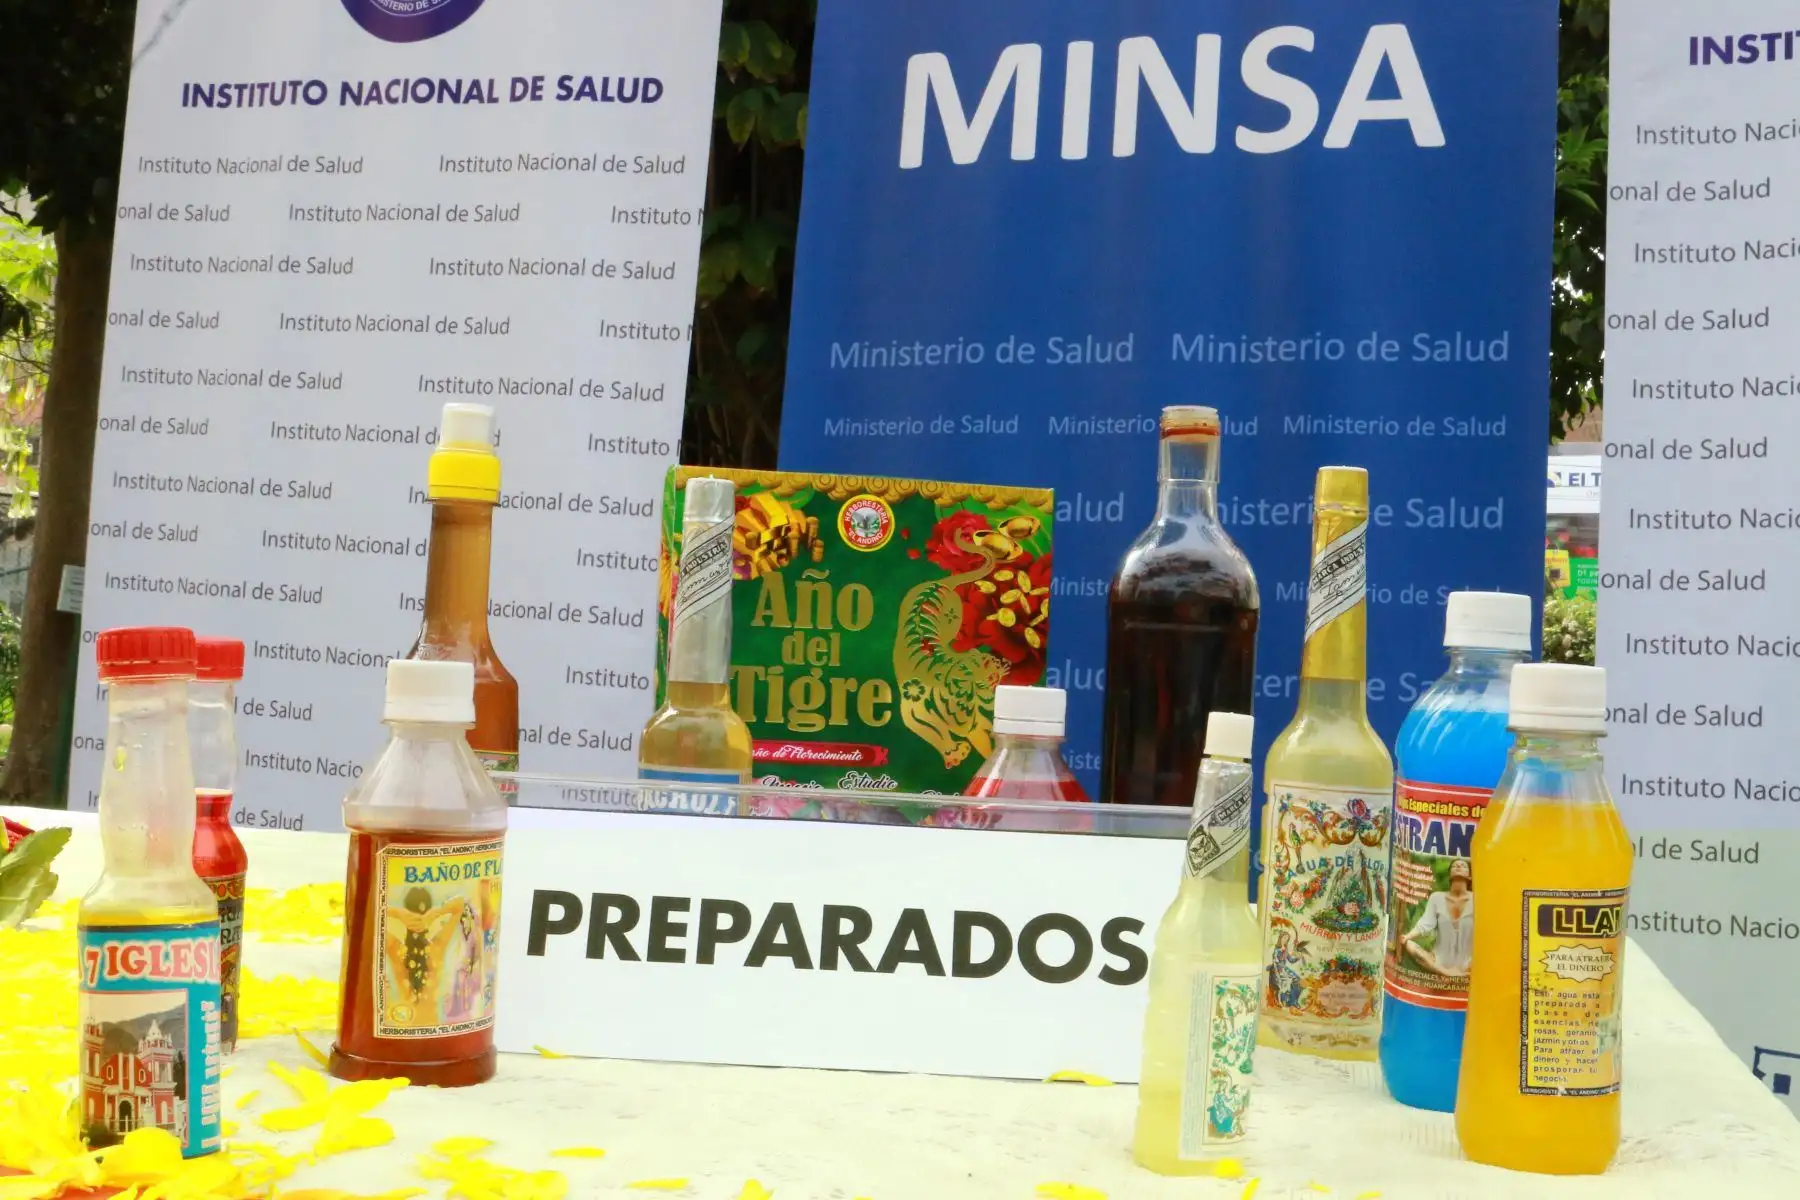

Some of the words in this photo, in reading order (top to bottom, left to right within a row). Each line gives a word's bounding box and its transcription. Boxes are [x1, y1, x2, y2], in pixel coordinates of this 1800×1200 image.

[183, 80, 327, 108] INSTITUTO
[340, 78, 499, 106] NACIONAL
[510, 76, 544, 102] DE
[556, 75, 663, 103] SALUD
[900, 24, 1445, 169] MINSA
[1637, 125, 1736, 144] Instituto
[139, 156, 211, 174] Instituto
[217, 156, 282, 174] Nacional
[288, 155, 309, 172] de
[315, 156, 363, 173] Salud
[440, 156, 512, 172] Instituto
[518, 154, 596, 171] Nacional
[603, 155, 627, 172] de
[633, 156, 685, 174] Salud
[1667, 182, 1695, 201] de
[1705, 177, 1770, 201] Salud
[157, 204, 179, 220] de
[185, 205, 229, 221] Salud
[290, 204, 361, 222] Instituto
[367, 204, 440, 221] Nacional
[446, 205, 468, 222] de
[474, 203, 519, 222] Salud
[612, 206, 691, 225] Instituto
[131, 254, 202, 273] Instituto
[208, 255, 273, 272] Nacional
[278, 256, 301, 273] de
[307, 257, 353, 274] Salud
[1636, 243, 1735, 263] Instituto
[430, 258, 503, 276] Instituto
[509, 258, 585, 275] Nacional
[592, 259, 616, 278] de
[623, 261, 675, 280] Salud
[149, 310, 170, 327] de
[176, 312, 219, 329] Salud
[280, 313, 351, 331] Instituto
[356, 315, 429, 332] Nacional
[436, 316, 458, 334] de
[464, 317, 509, 334] Salud
[1665, 310, 1694, 330] de
[1703, 307, 1769, 330] Salud
[600, 320, 680, 341] Instituto
[831, 337, 984, 368] Ministerio
[996, 335, 1035, 363] de
[1047, 333, 1133, 363] Salud
[1172, 332, 1344, 363] Ministerio
[1357, 331, 1400, 361] de
[1412, 331, 1508, 361] Salud
[122, 366, 193, 385] Instituto
[198, 369, 263, 386] Nacional
[269, 370, 291, 388] de
[297, 372, 342, 389] Salud
[419, 375, 493, 395] Instituto
[499, 378, 573, 396] Nacional
[580, 379, 604, 398] de
[610, 381, 664, 401] Salud
[1633, 379, 1734, 399] Instituto
[141, 416, 162, 433] de
[167, 418, 208, 435] Salud
[271, 421, 341, 441] Instituto
[346, 424, 419, 443] Nacional
[825, 417, 923, 436] Ministerio
[930, 415, 954, 433] de
[961, 415, 1018, 433] Salud
[1049, 415, 1155, 434] Ministerio
[1284, 415, 1399, 435] Ministerio
[1407, 416, 1435, 435] de
[1443, 416, 1505, 436] Salud
[589, 434, 670, 456] Instituto
[1663, 439, 1692, 459] de
[1701, 437, 1767, 459] Salud
[113, 472, 183, 491] Instituto
[187, 476, 254, 495] Nacional
[260, 479, 282, 497] de
[288, 481, 332, 499] Salud
[568, 494, 593, 512] de
[599, 496, 653, 517] Salud
[1405, 497, 1503, 528] Salud
[1630, 509, 1731, 529] Instituto
[132, 522, 153, 540] de
[158, 524, 198, 542] Salud
[263, 530, 331, 550] Instituto
[336, 535, 409, 555] Nacional
[577, 549, 658, 572] Instituto
[106, 572, 173, 593] Instituto
[178, 578, 246, 598] Nacional
[252, 582, 274, 600] de
[279, 584, 322, 603] Salud
[1660, 570, 1689, 590] de
[1698, 569, 1765, 590] Salud
[751, 569, 874, 630] Año
[558, 603, 581, 622] de
[588, 606, 643, 627] Salud
[255, 641, 321, 662] Instituto
[782, 630, 840, 667] del
[1627, 633, 1729, 655] Instituto
[567, 666, 649, 690] Instituto
[730, 664, 892, 732] Tigre
[243, 698, 264, 716] de
[269, 700, 312, 721] Salud
[1656, 704, 1686, 725] de
[1695, 705, 1762, 727] Salud
[548, 727, 571, 746] de
[577, 729, 632, 751] Salud
[246, 750, 311, 773] Instituto
[773, 747, 787, 758] de
[783, 744, 863, 761] Florecimiento
[839, 771, 898, 790] Estudio
[1623, 774, 1725, 798] Instituto
[235, 807, 255, 825] de
[260, 810, 303, 831] Salud
[1652, 838, 1682, 859] de
[1691, 840, 1758, 864] Salud
[404, 862, 460, 883] BAÑO
[464, 861, 481, 879] DE
[526, 889, 1148, 986] PREPARADOS
[87, 948, 99, 985] 7
[1550, 953, 1574, 961] PARA
[1577, 955, 1610, 963] ATRAER
[1570, 964, 1604, 972] DINERO
[1534, 1055, 1560, 1063] dinero
